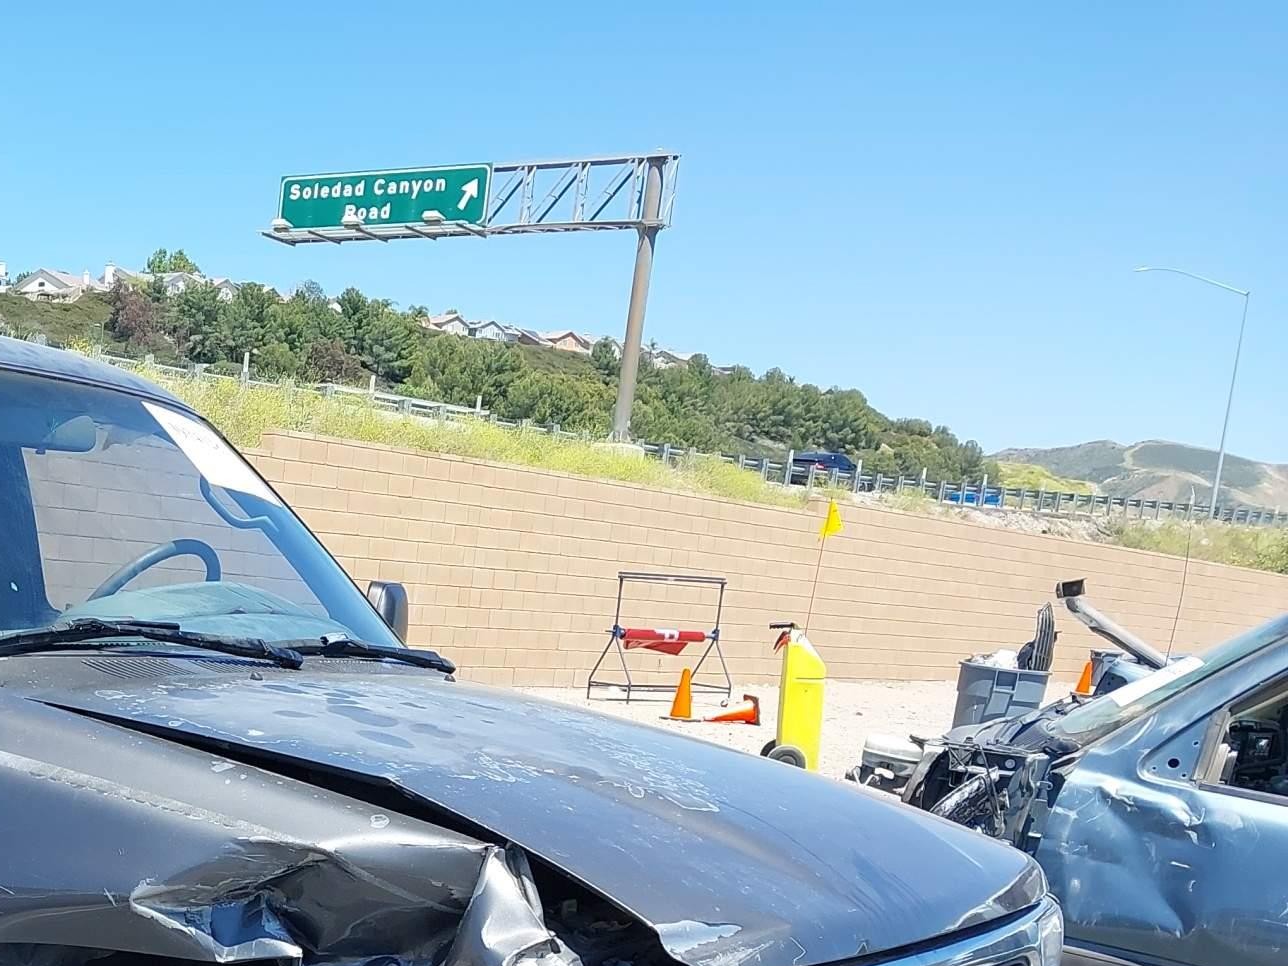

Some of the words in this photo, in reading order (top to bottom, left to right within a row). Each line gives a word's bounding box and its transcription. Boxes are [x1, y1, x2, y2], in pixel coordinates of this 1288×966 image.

[289, 180, 366, 200] Soledad
[373, 178, 446, 199] Canyon
[342, 203, 391, 221] Road
